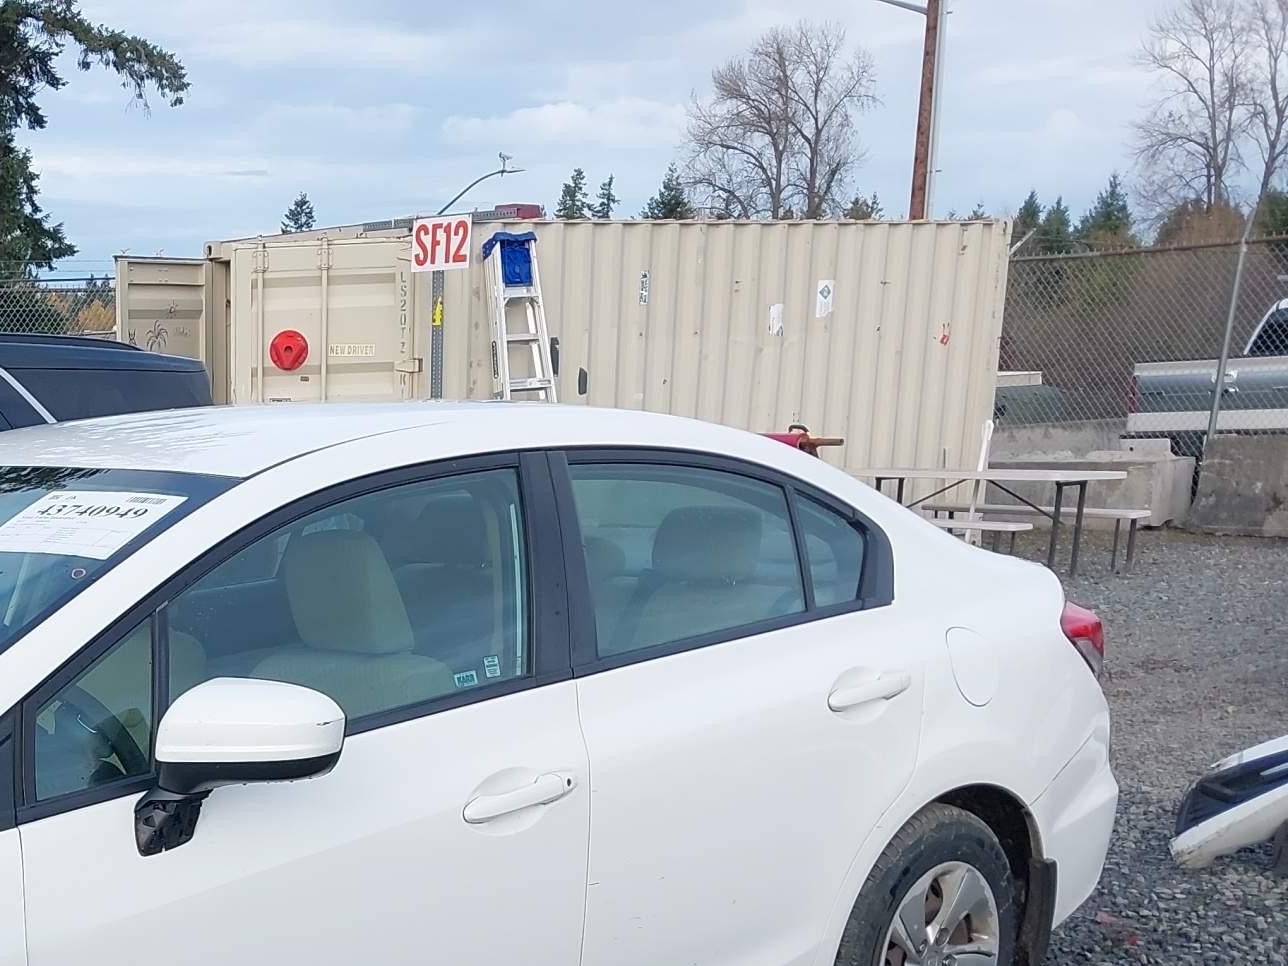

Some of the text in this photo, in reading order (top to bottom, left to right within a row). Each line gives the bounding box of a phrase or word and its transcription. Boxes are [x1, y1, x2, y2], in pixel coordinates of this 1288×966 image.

[414, 220, 469, 267] SF12
[329, 345, 346, 355] NEW
[38, 504, 149, 519] 43740949
